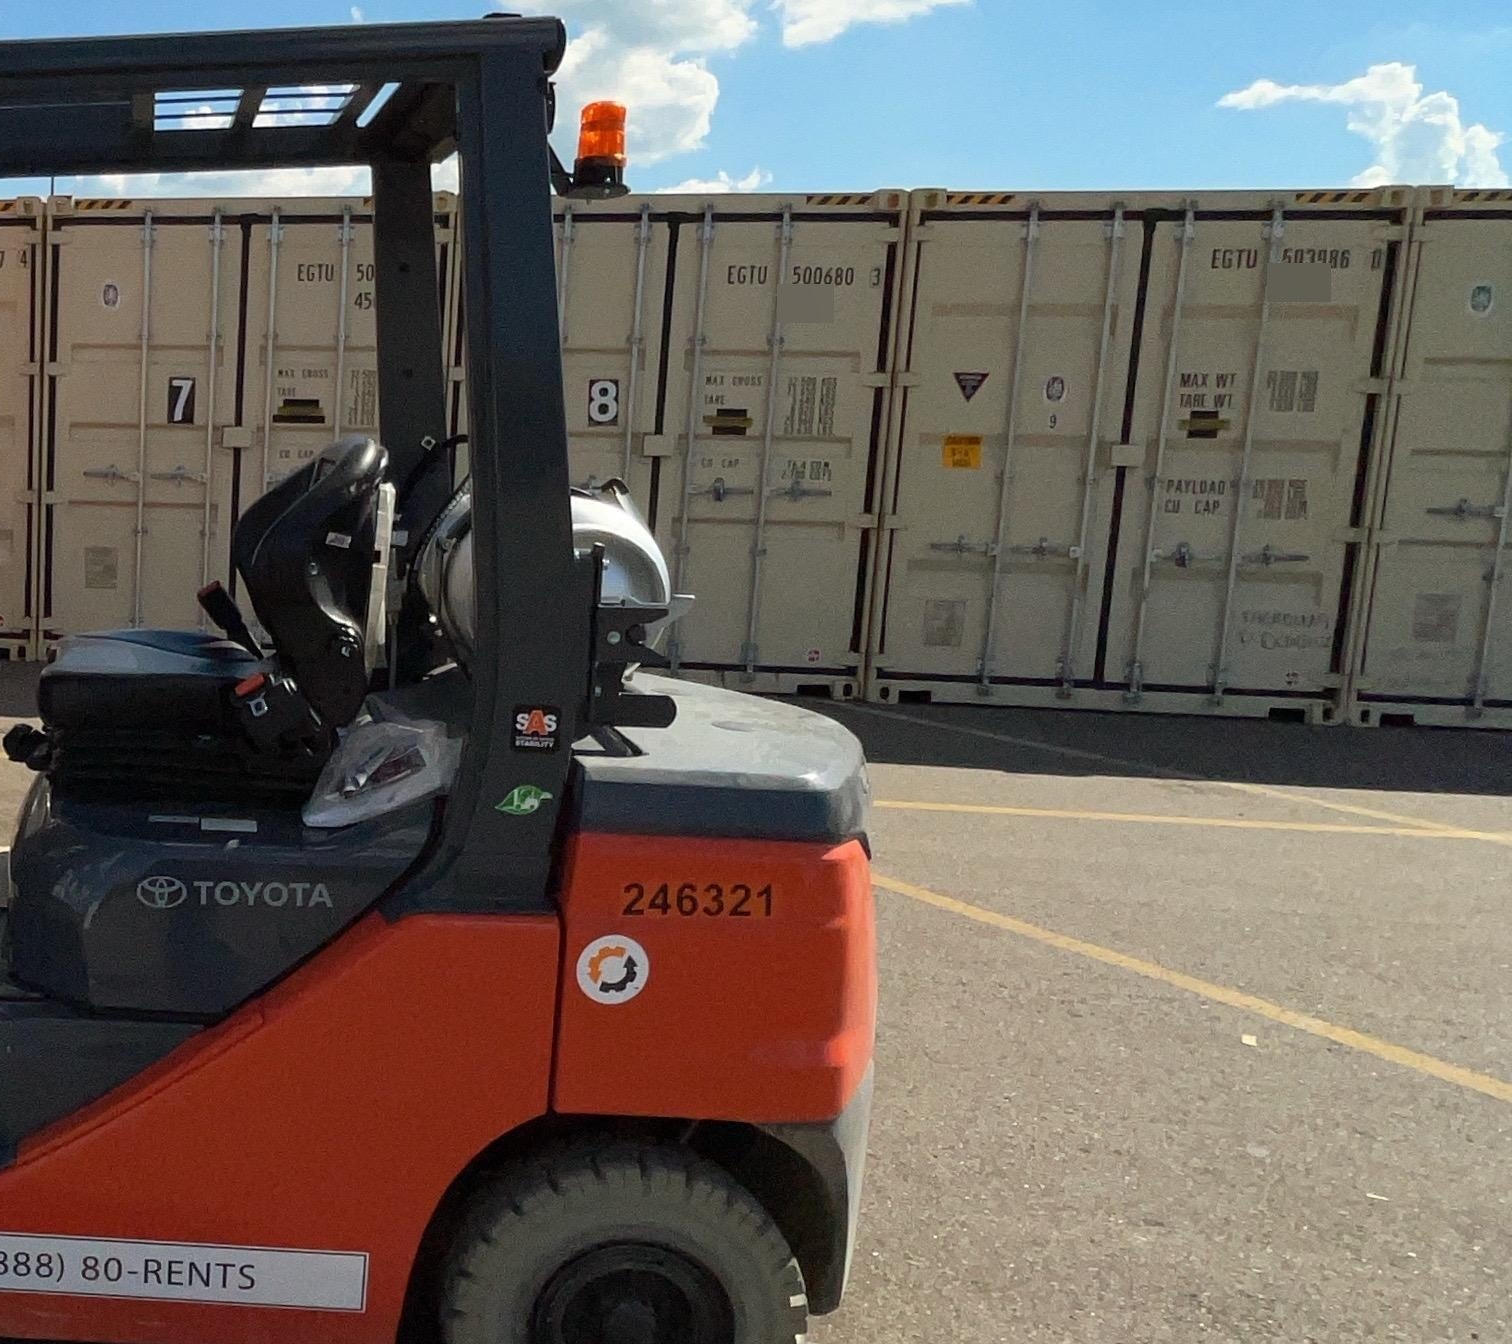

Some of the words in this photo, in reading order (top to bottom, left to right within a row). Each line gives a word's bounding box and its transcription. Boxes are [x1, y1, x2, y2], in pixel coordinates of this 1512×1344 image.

[1210, 248, 1258, 269] EGTU
[297, 263, 335, 282] EGTU
[727, 265, 769, 285] EGTU
[791, 266, 855, 286] 500680
[1180, 373, 1208, 388] MAX
[172, 379, 194, 422] 7
[589, 380, 618, 422] 8
[1049, 414, 1057, 429] 9
[1194, 500, 1221, 515] CAP
[515, 709, 558, 736] SAS
[192, 880, 334, 908] TOYOTA
[622, 883, 774, 917] 246321
[80, 1255, 257, 1290] 80-RENTS
